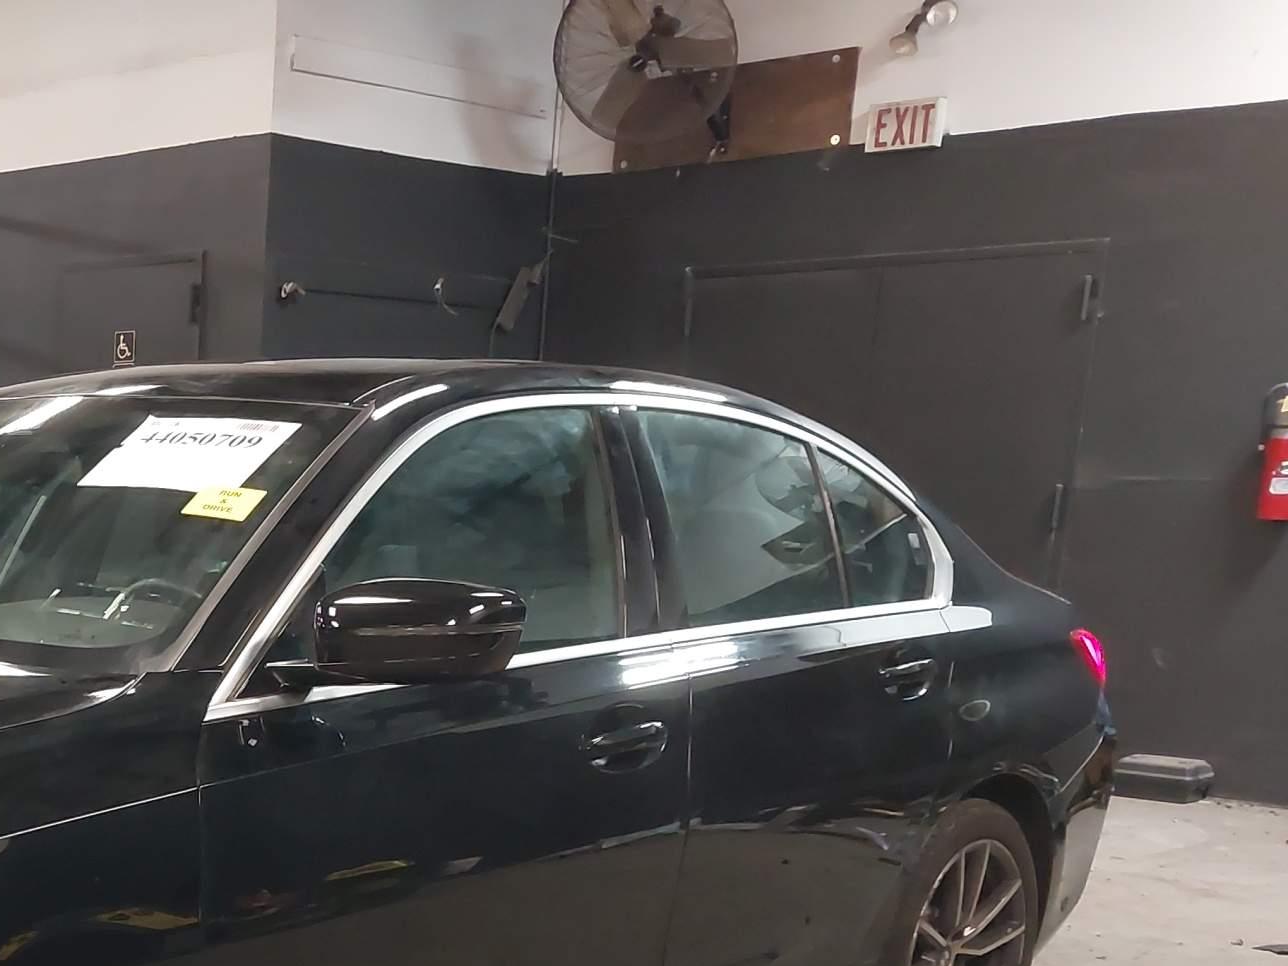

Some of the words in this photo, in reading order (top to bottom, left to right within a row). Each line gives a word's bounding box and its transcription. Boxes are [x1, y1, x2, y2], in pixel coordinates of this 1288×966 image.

[874, 103, 936, 148] EXIT
[140, 431, 263, 448] 44050709
[202, 504, 232, 512] DRIVE
